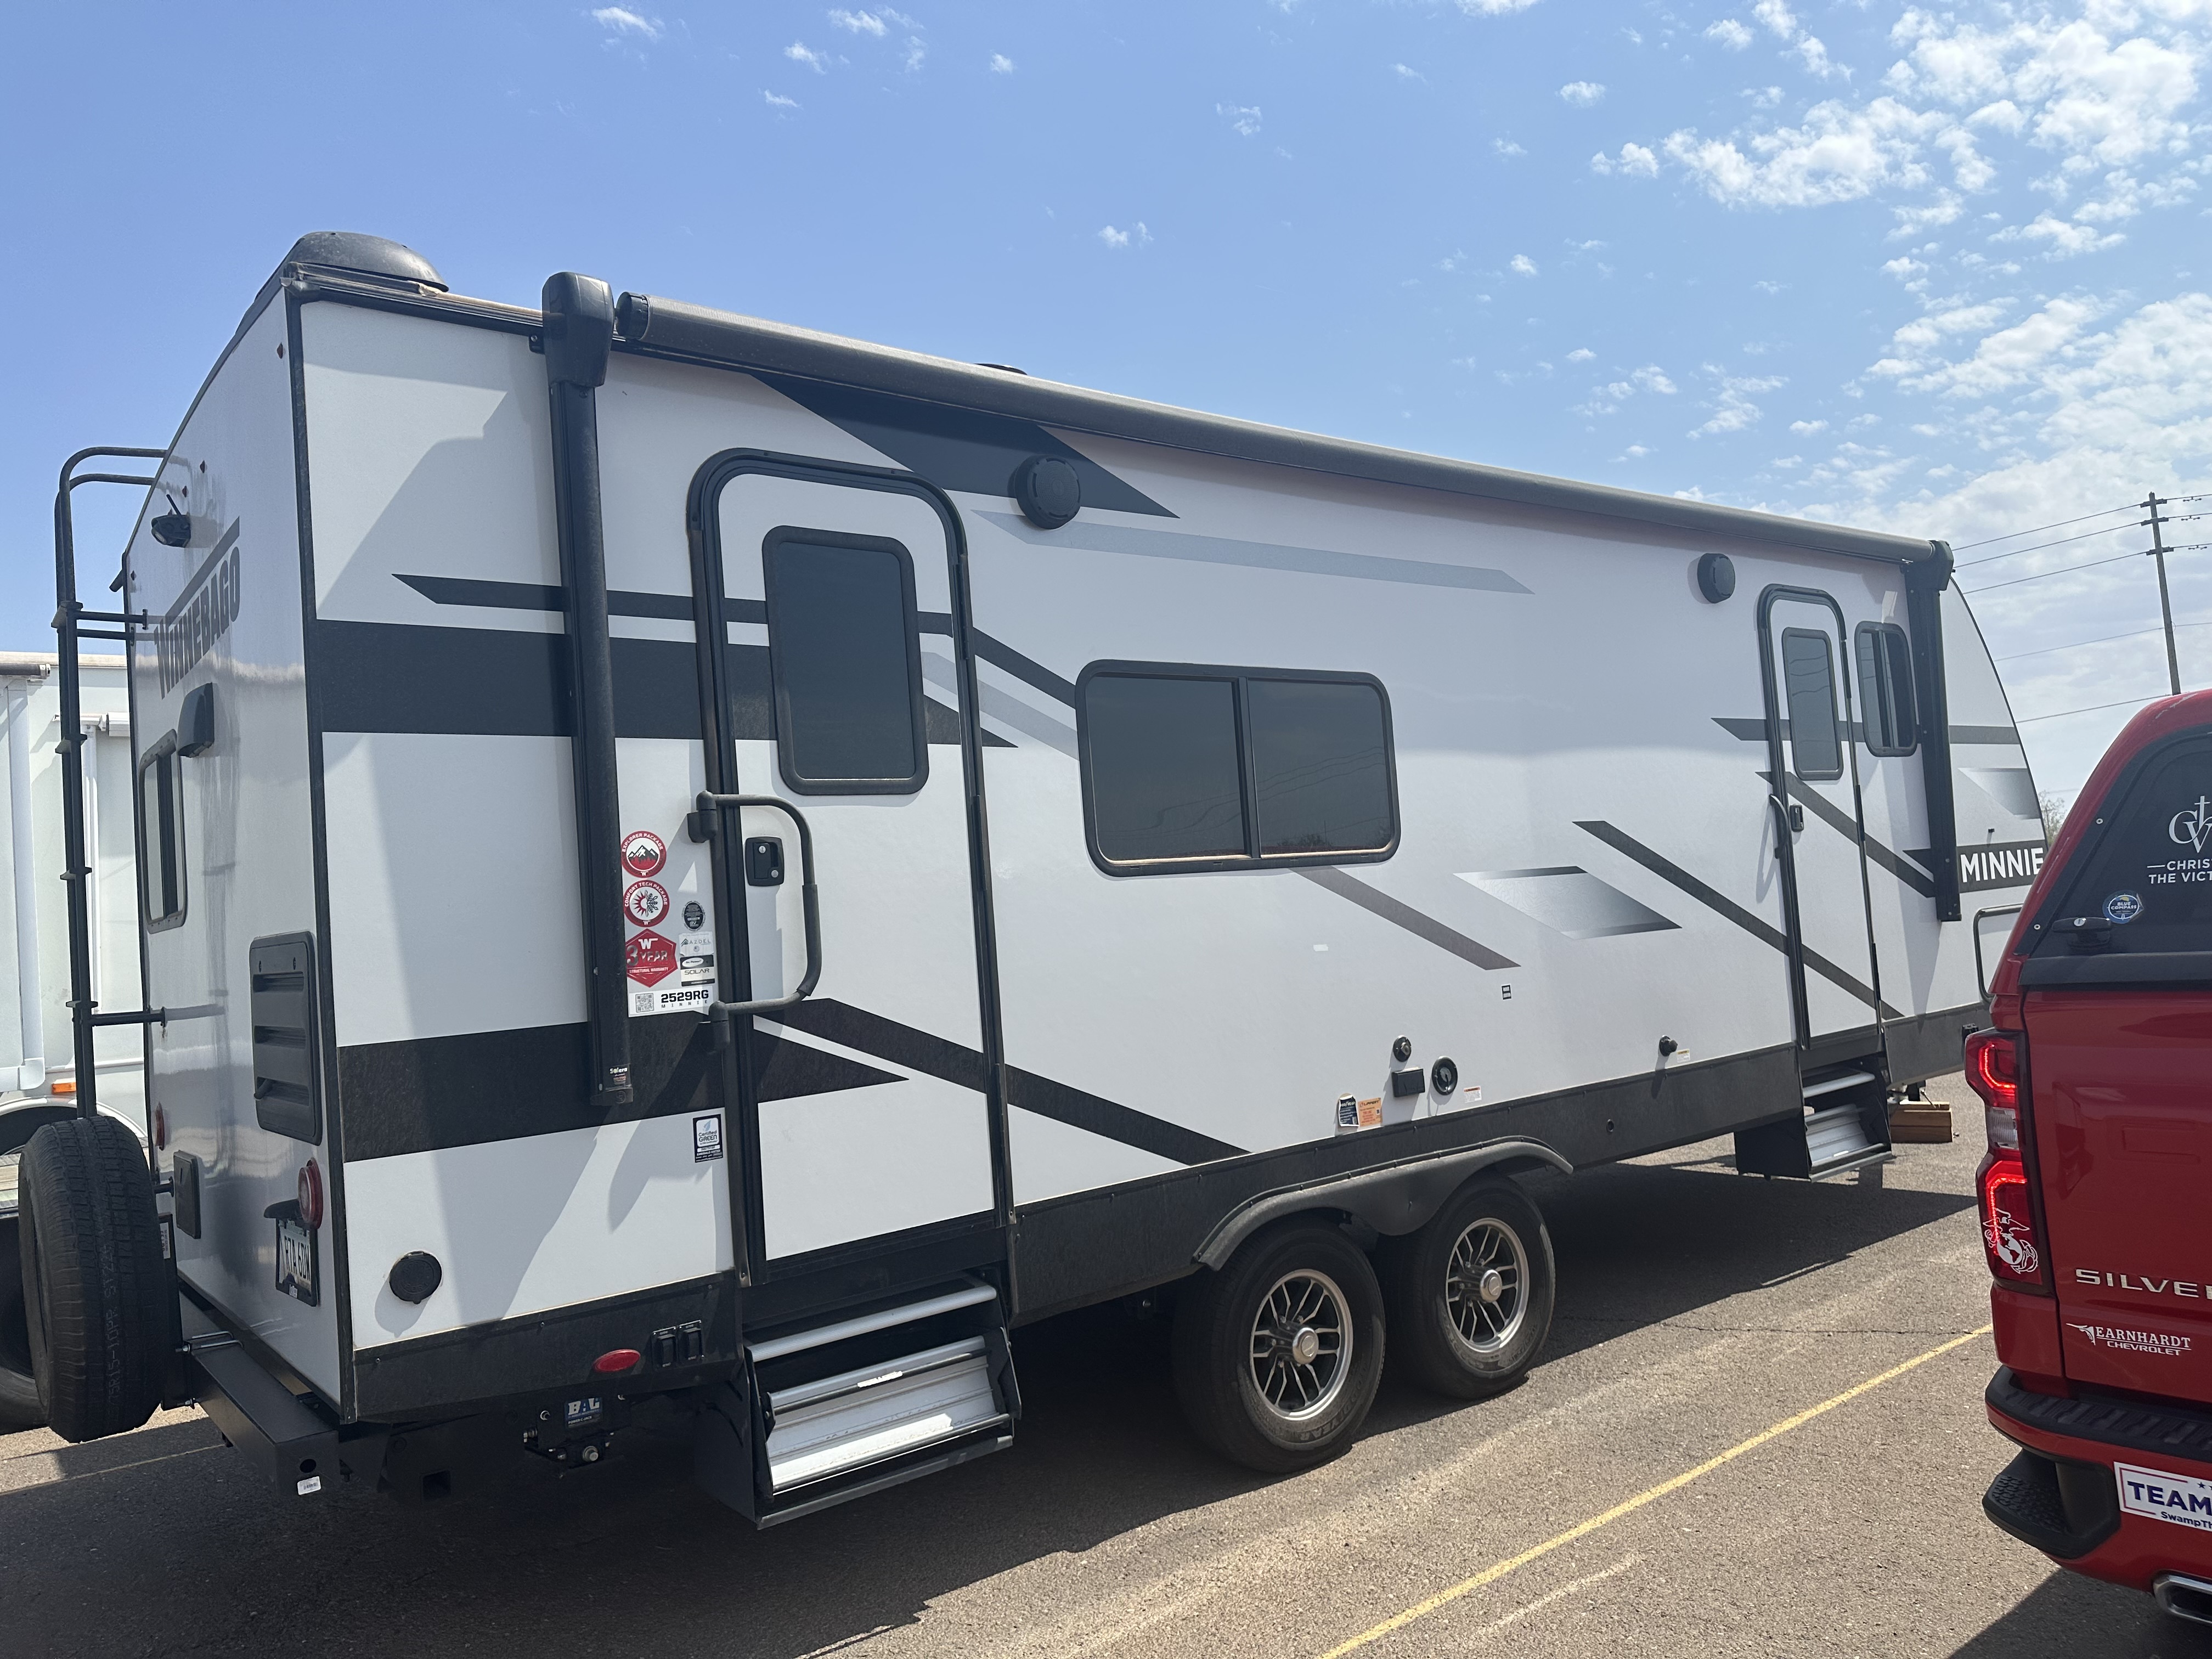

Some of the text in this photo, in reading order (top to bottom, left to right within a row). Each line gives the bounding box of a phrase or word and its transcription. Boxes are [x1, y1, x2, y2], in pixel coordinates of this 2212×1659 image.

[154, 546, 240, 700] WINNEBAGO
[622, 833, 664, 852] EXPLORER PACKAGE
[1960, 847, 2044, 883] MINNIE
[2167, 859, 2212, 871] CHRIS
[2148, 873, 2176, 884] THE
[624, 884, 638, 907] COMFORT
[653, 883, 668, 905] PACKAGE
[627, 945, 668, 966] 3 YEAR
[661, 989, 709, 1003] 2529RG
[661, 1000, 708, 1008] MINNIE
[2075, 1268, 2212, 1300] SILVE
[2095, 1327, 2191, 1348] EARNHARDT
[2107, 1341, 2181, 1356] CHEVROLET
[2127, 1481, 2212, 1516] TEAM
